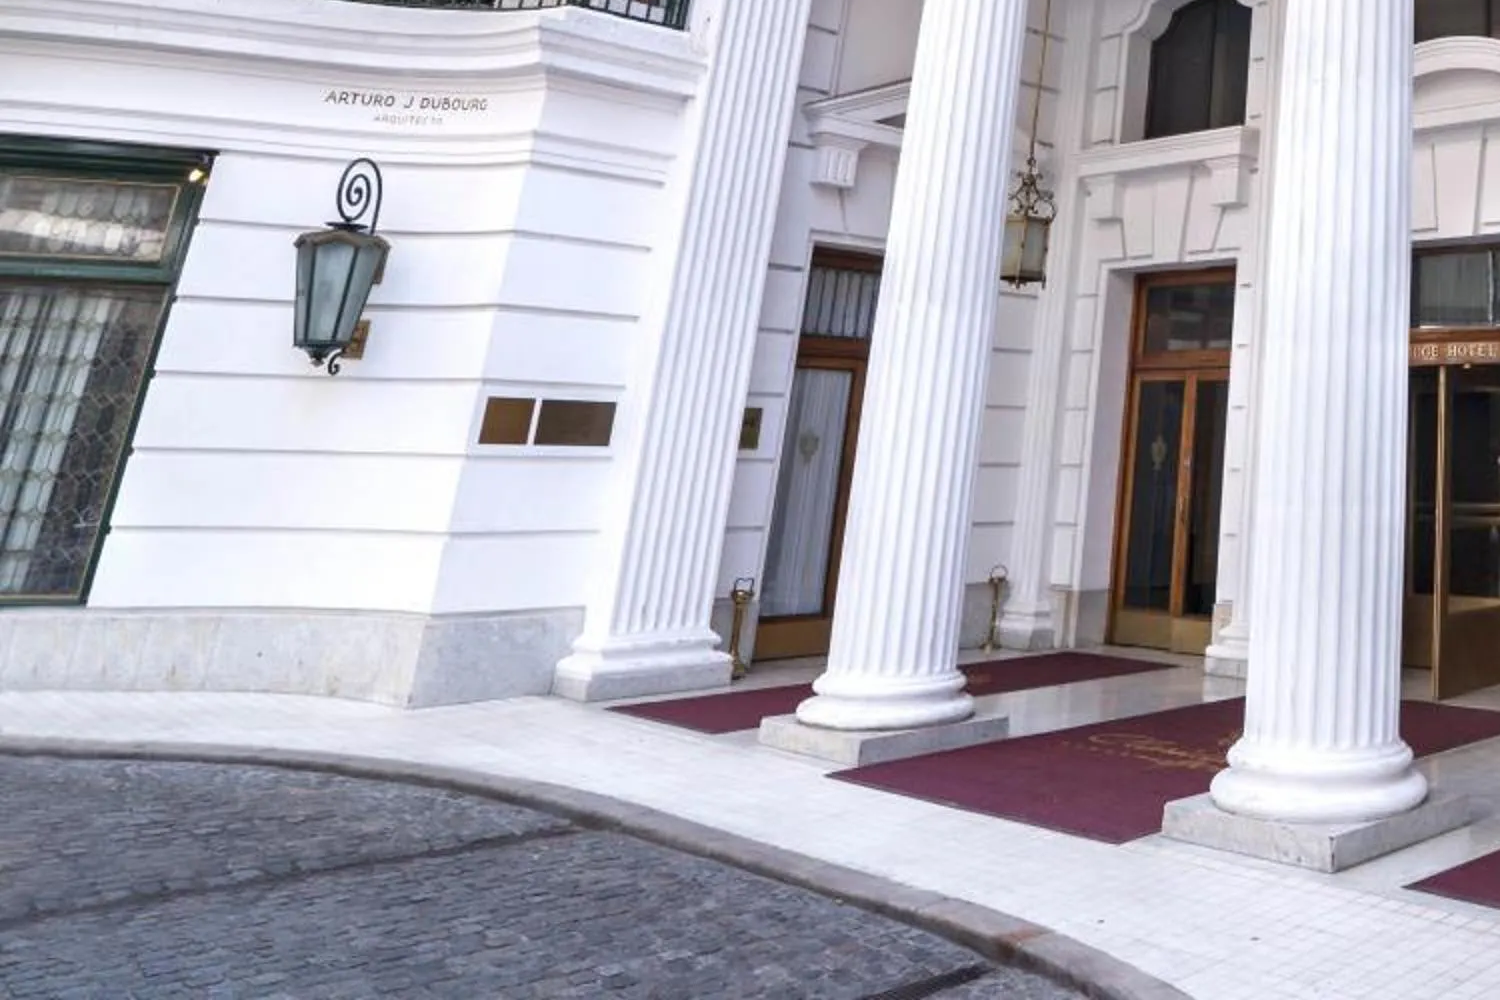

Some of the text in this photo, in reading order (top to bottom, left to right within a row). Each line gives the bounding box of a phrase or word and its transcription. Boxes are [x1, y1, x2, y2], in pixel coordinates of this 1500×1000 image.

[325, 90, 489, 111] ARTURO J DUBOURG
[1447, 343, 1497, 358] HOTEL
